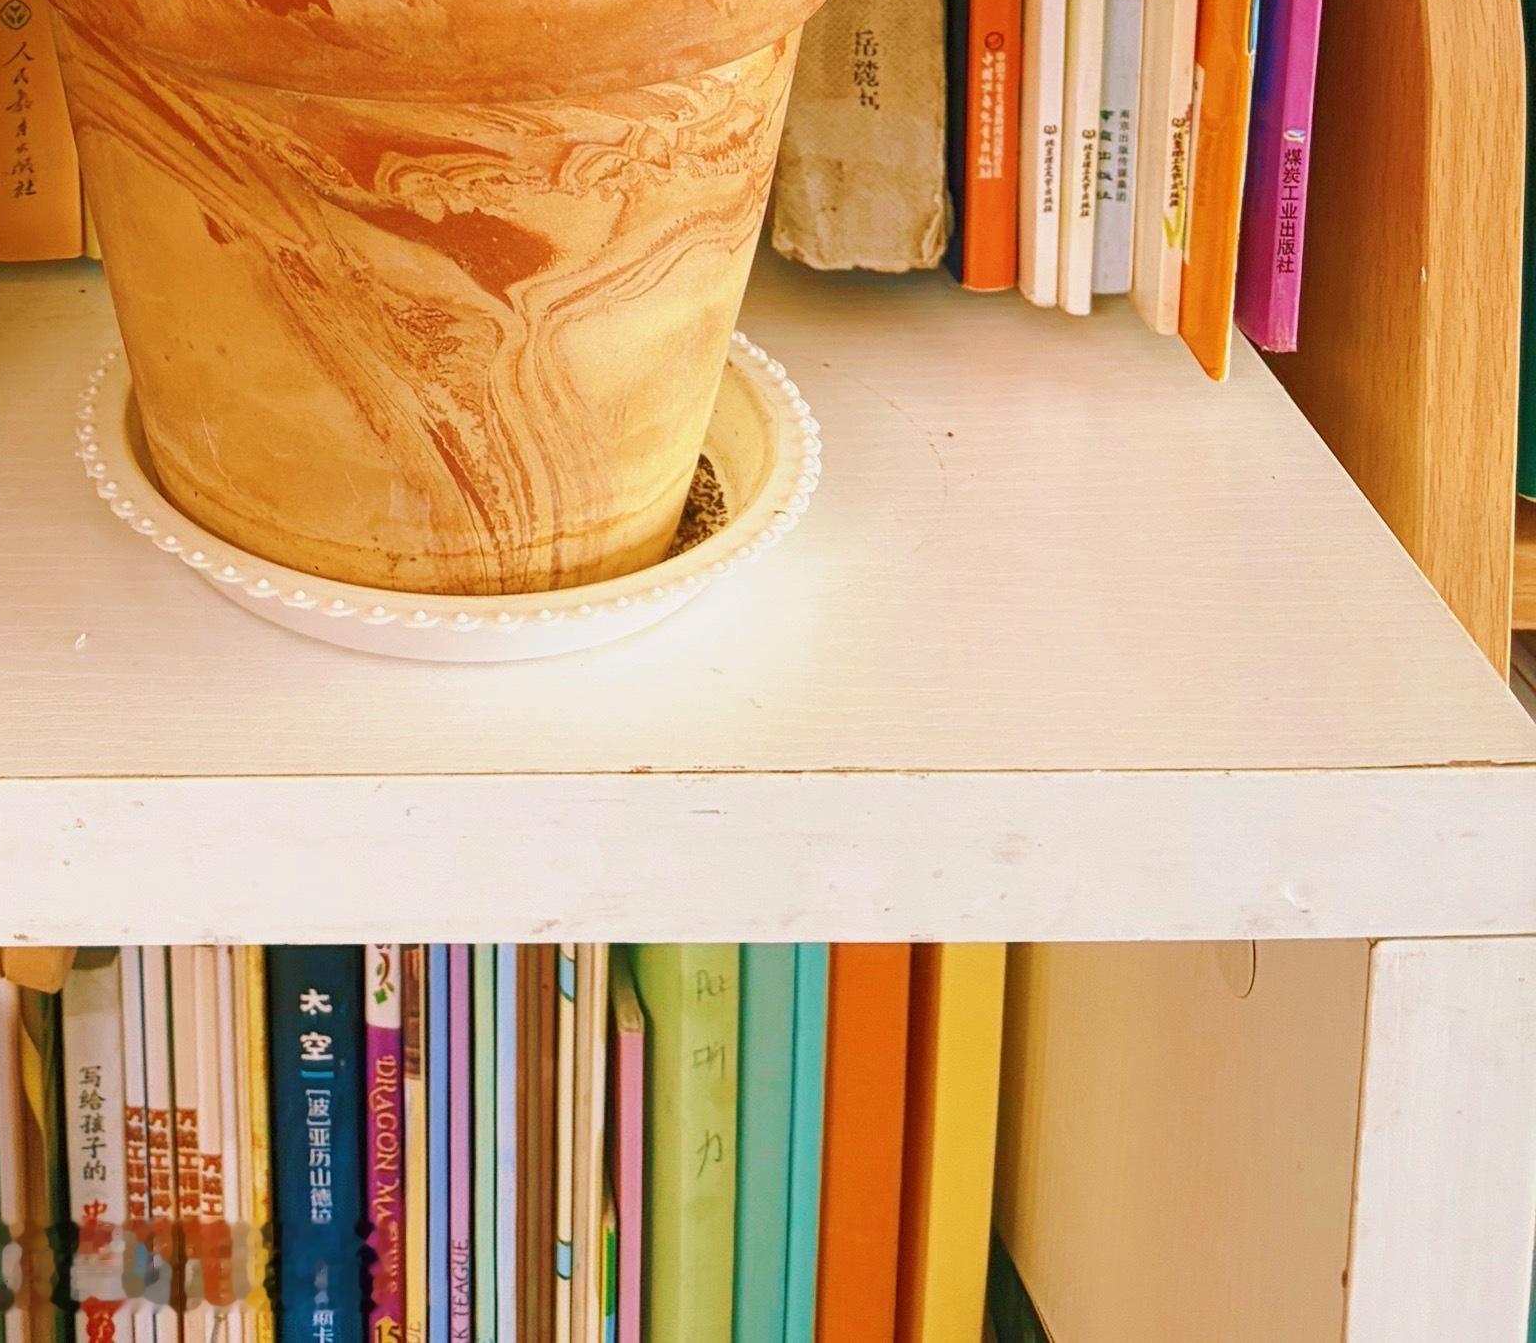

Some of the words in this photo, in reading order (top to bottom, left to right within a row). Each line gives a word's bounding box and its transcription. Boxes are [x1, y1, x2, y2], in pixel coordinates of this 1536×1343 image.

[1276, 147, 1303, 275] 煤炭工业出版社
[300, 988, 334, 1061] 太空
[370, 1055, 401, 1172] DRAGON
[452, 1239, 470, 1316] TEAGUE
